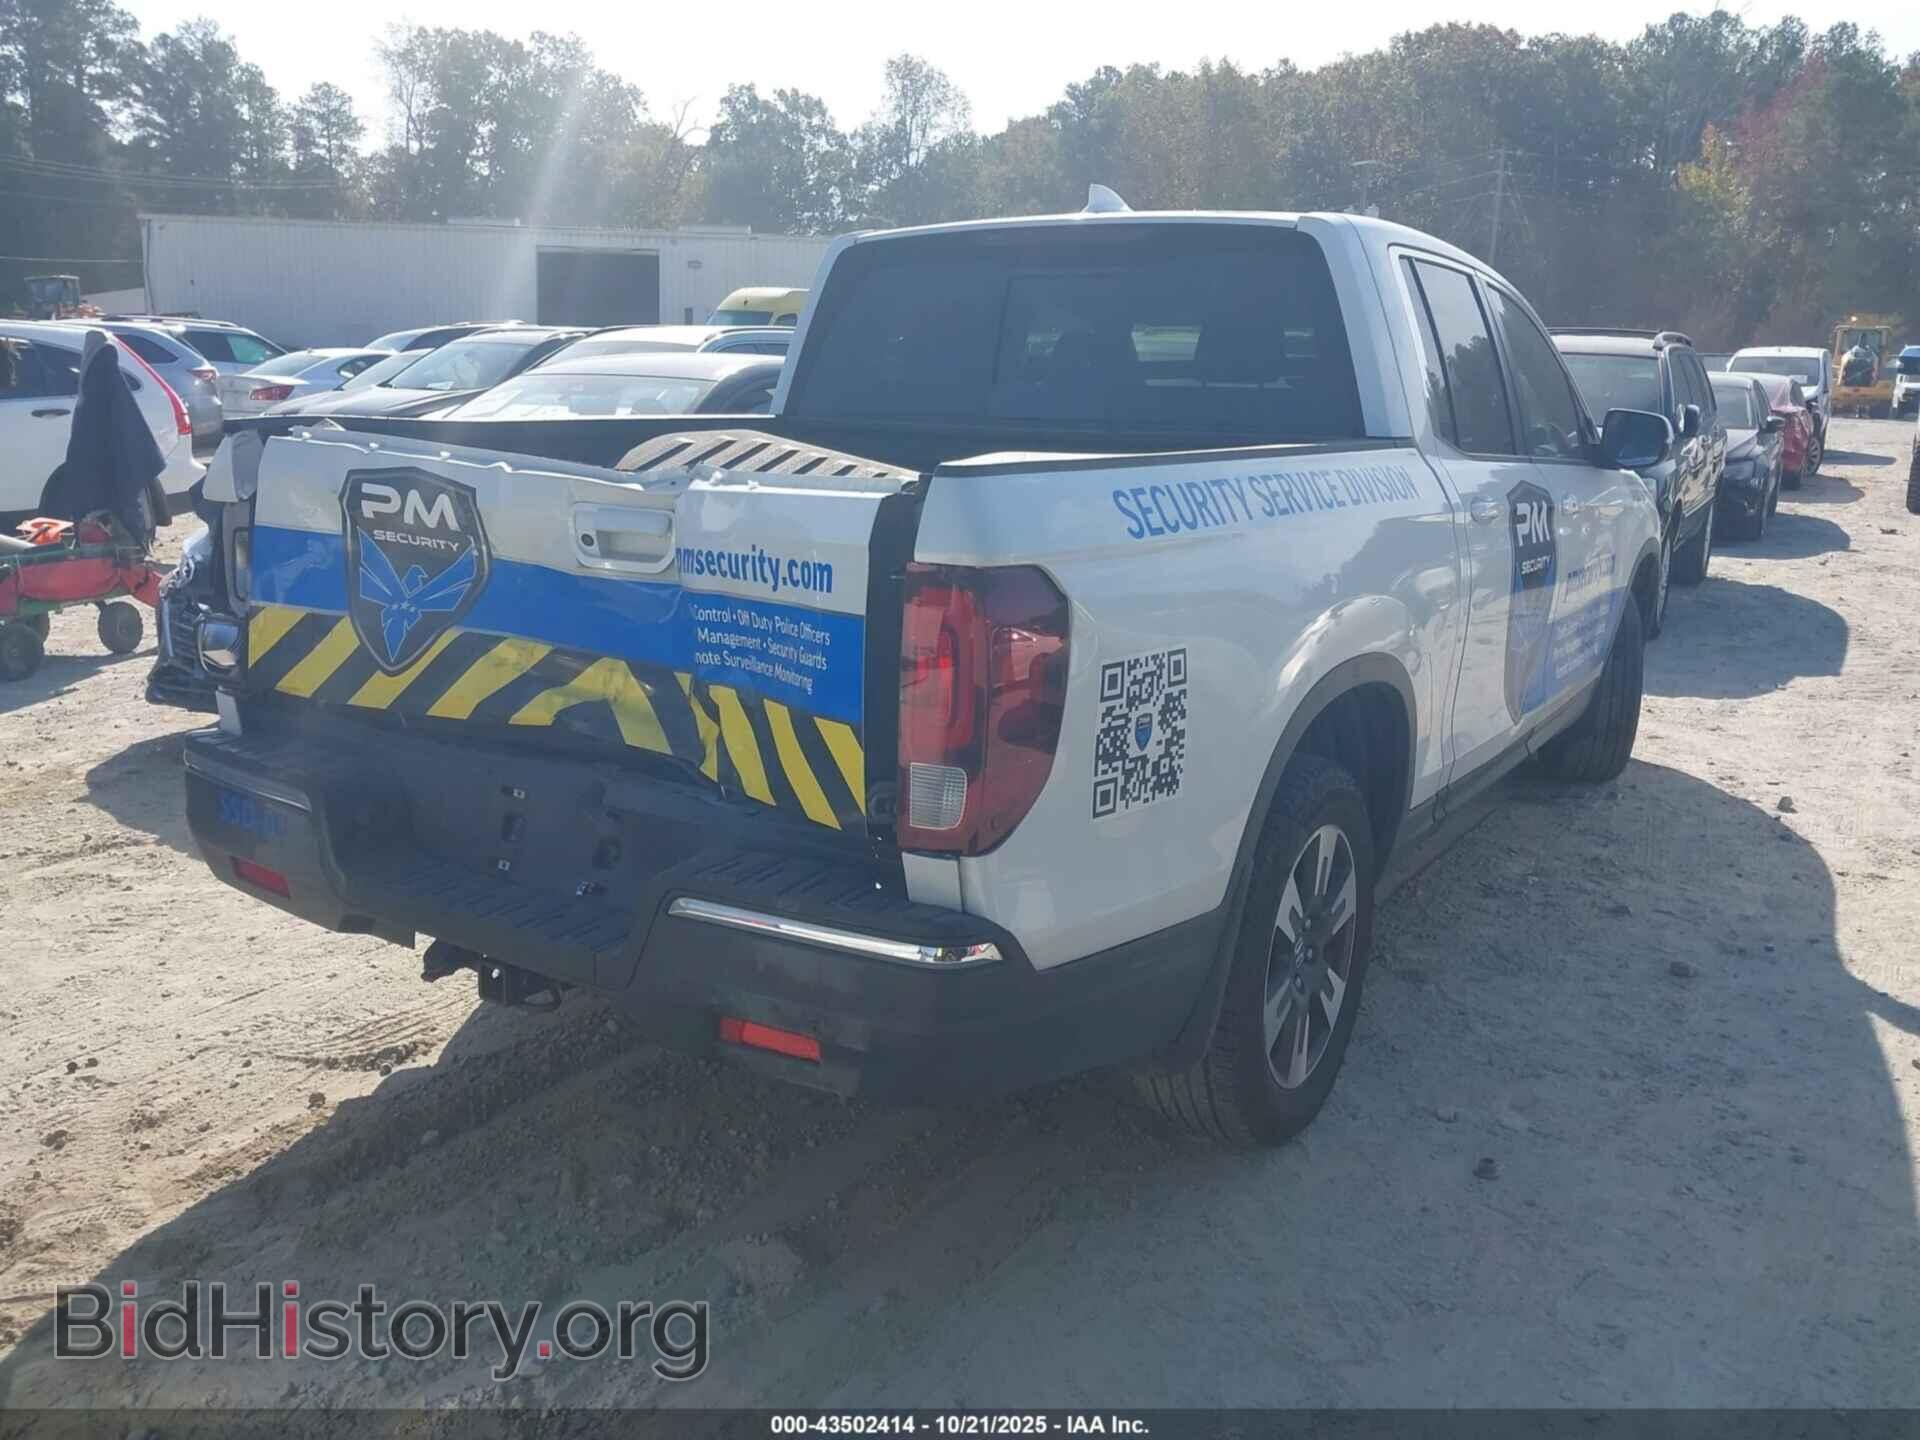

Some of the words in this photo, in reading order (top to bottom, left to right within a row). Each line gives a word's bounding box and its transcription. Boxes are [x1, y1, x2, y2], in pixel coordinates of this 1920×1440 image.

[360, 482, 462, 532] PM
[1112, 477, 1253, 540] SECURITY
[1248, 469, 1346, 518] SERVICE
[1338, 464, 1421, 506] DIVISION
[1516, 501, 1551, 547] PM
[373, 529, 461, 553] SECURITY
[1520, 555, 1552, 576] SECURITY
[697, 627, 761, 650] Management
[767, 637, 798, 664] Security
[800, 646, 828, 670] Guards
[750, 611, 773, 634] Duty
[774, 615, 799, 638] Police
[800, 621, 831, 646] Officers
[723, 650, 774, 677] Surveillance
[774, 662, 813, 695] Monitoring
